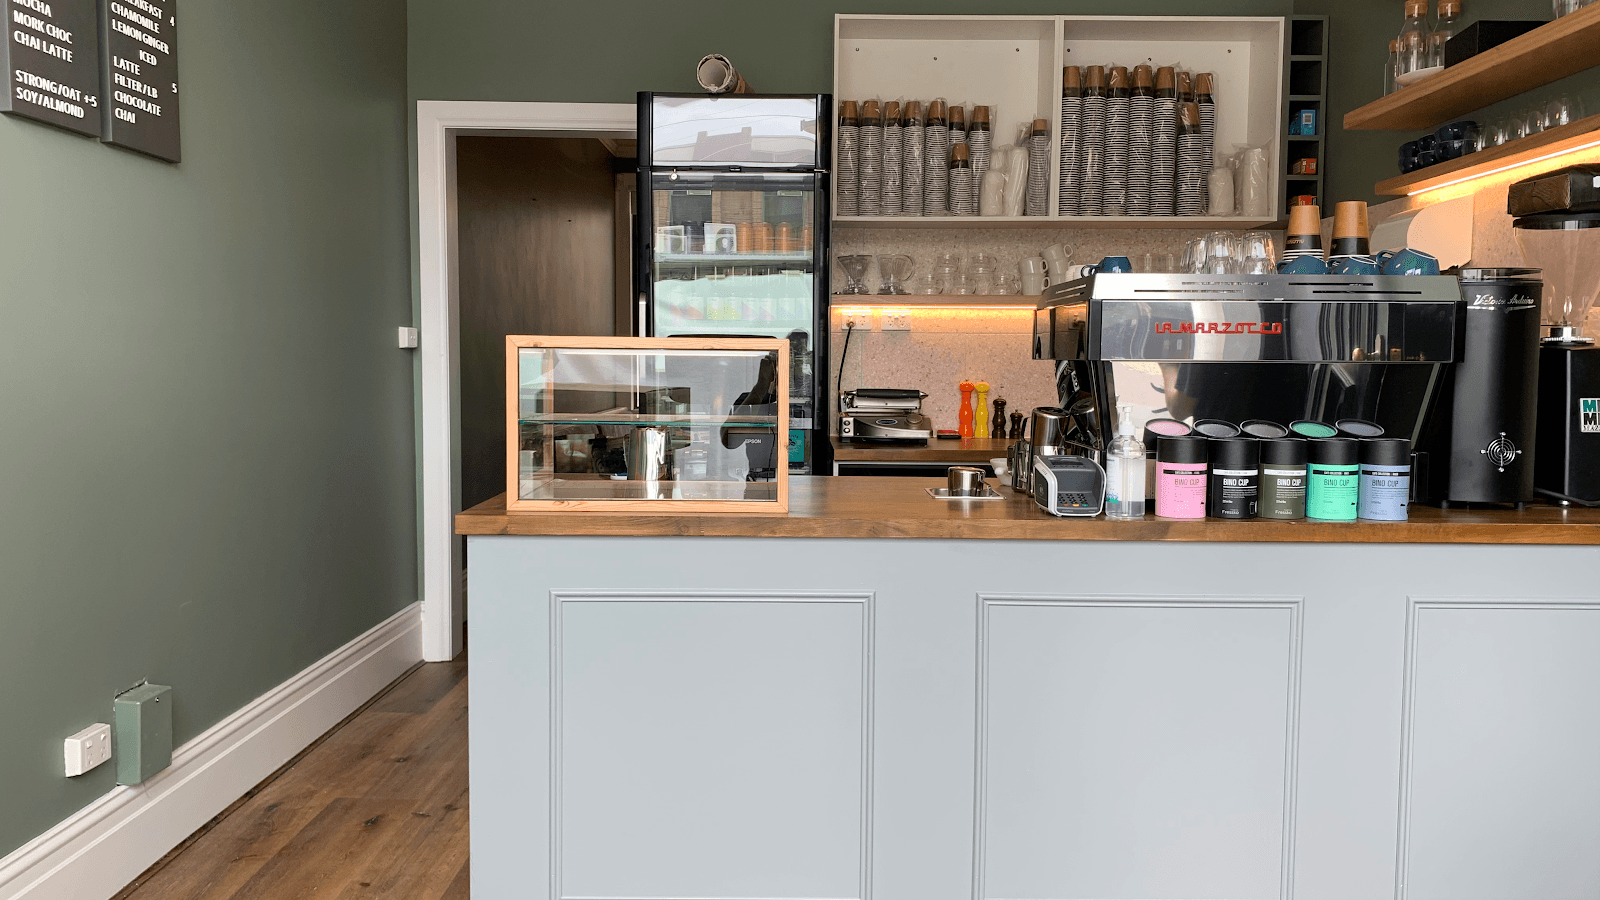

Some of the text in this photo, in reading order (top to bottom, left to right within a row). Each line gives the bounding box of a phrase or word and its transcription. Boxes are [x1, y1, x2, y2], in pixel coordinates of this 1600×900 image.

[13, 0, 52, 18] OCHA
[111, 1, 160, 34] CHAMOMILE
[13, 9, 73, 45] MORK CHOC
[169, 16, 175, 27] 4
[112, 18, 170, 55] LEMON GINGER
[13, 30, 73, 63] CHAI LATTE
[113, 55, 141, 76] LATTE
[139, 49, 157, 66] ICED
[15, 69, 82, 102] STRONG/OAT
[171, 82, 178, 94] 5
[16, 86, 85, 119] SOY/ALMOND
[114, 90, 162, 117] CHOCOLATE
[114, 107, 136, 124] CHAI
[1223, 478, 1250, 487] BINO CUP
[1276, 478, 1302, 487] BINO CUP
[1338, 479, 1350, 487] CUP
[1387, 479, 1399, 488] CUP
